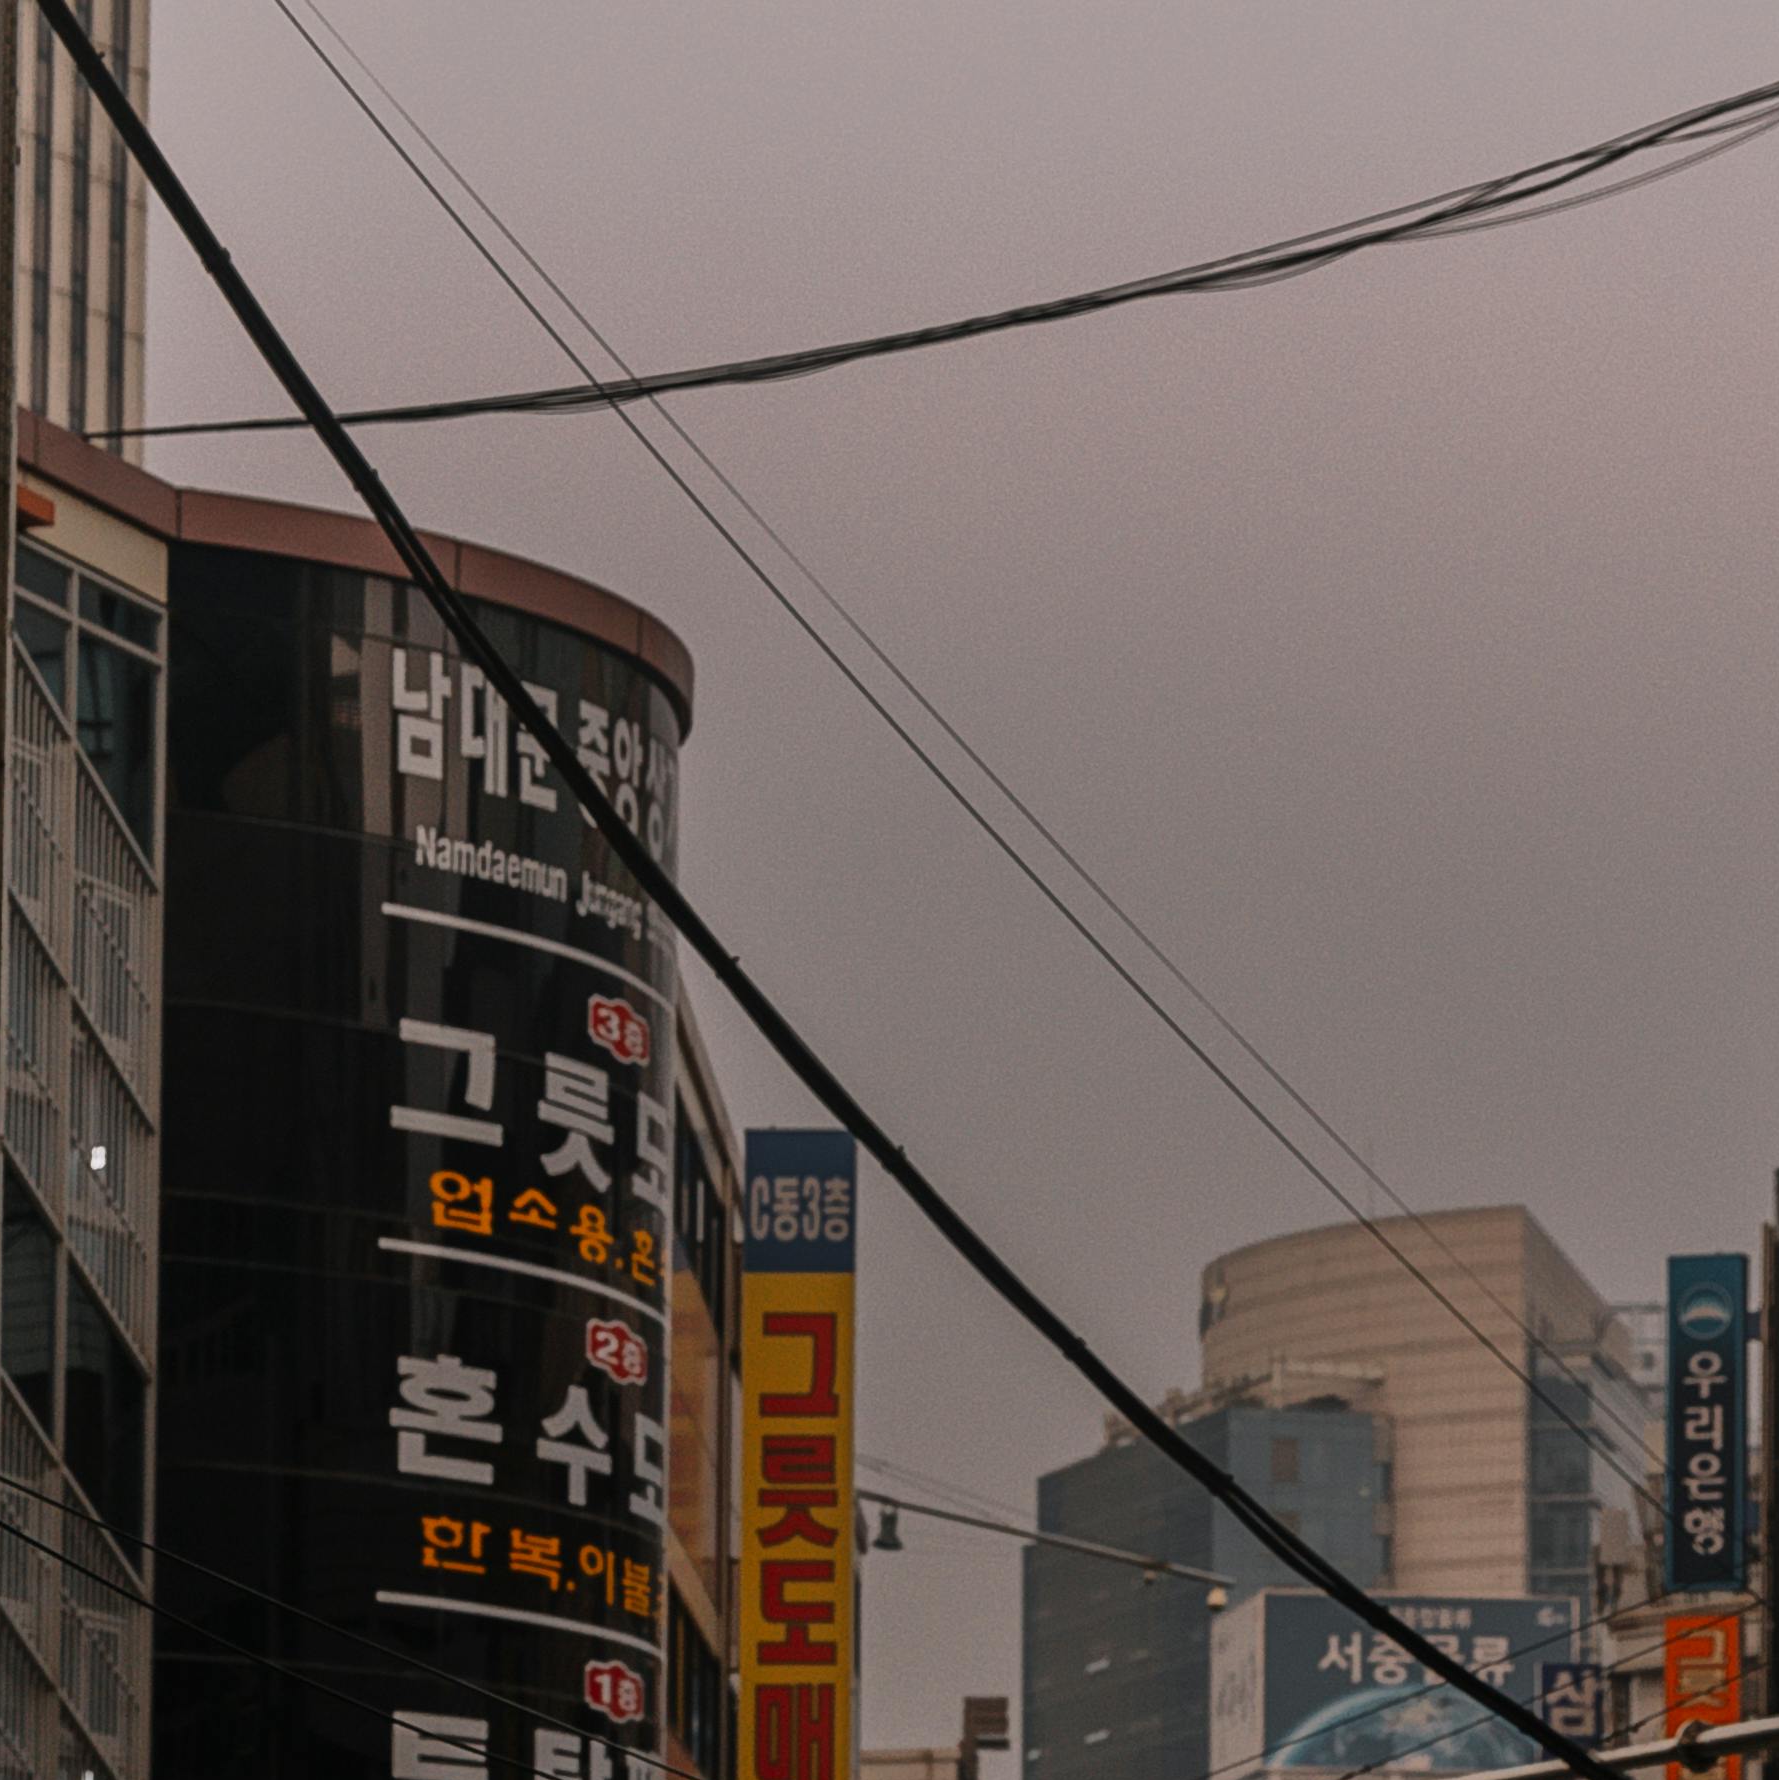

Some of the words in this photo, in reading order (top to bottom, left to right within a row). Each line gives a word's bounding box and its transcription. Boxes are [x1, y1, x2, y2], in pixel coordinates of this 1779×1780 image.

[392, 646, 558, 813] 남대문
[415, 824, 568, 904] Namdaemun
[749, 1174, 851, 1242] C동3층
[1680, 1351, 1727, 1556] 우리은행
